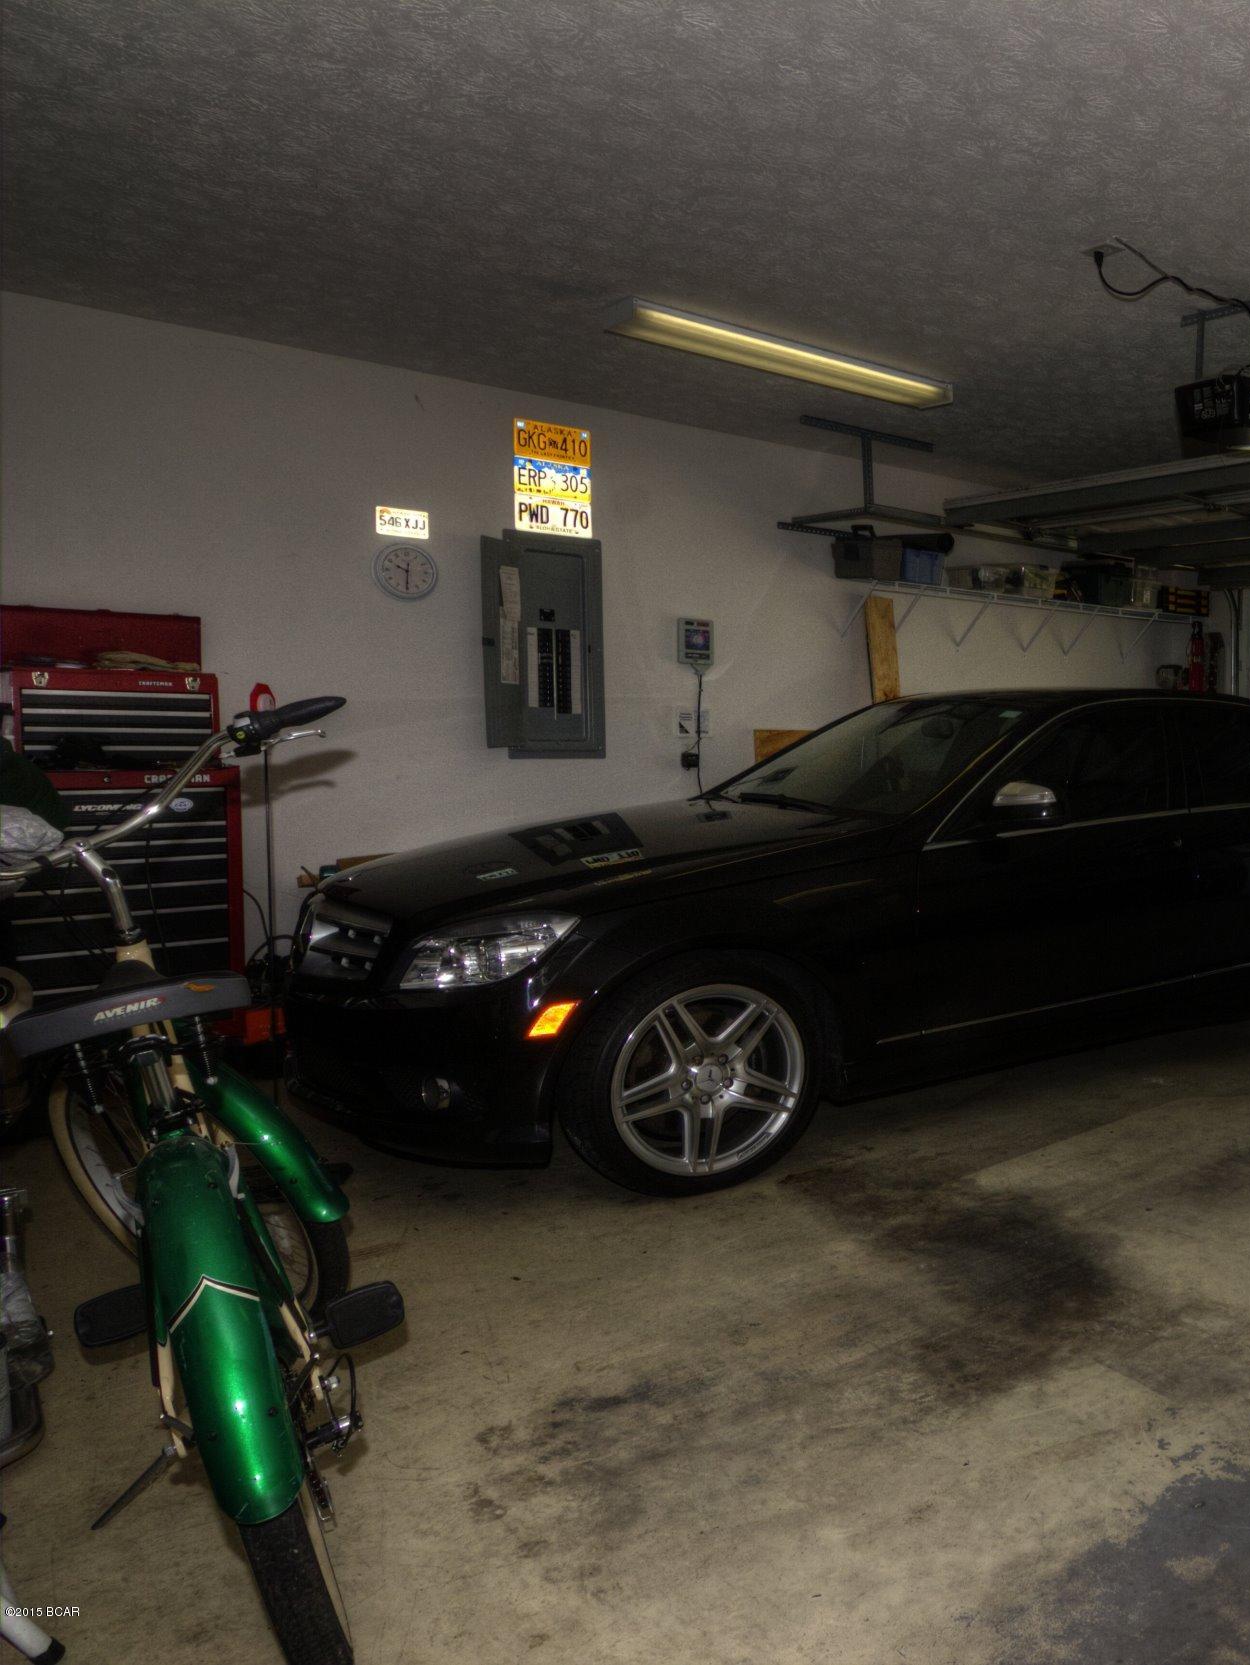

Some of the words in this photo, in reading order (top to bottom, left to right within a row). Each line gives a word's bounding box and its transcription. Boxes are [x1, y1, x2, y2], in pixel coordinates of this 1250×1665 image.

[518, 429, 547, 451] GKG
[560, 437, 588, 457] 410
[533, 425, 572, 436] ALASKA
[518, 467, 547, 487] ERP
[560, 474, 588, 494] 305
[518, 501, 549, 524] PWD
[560, 507, 589, 529] 770
[94, 997, 161, 1022] AVENIR
